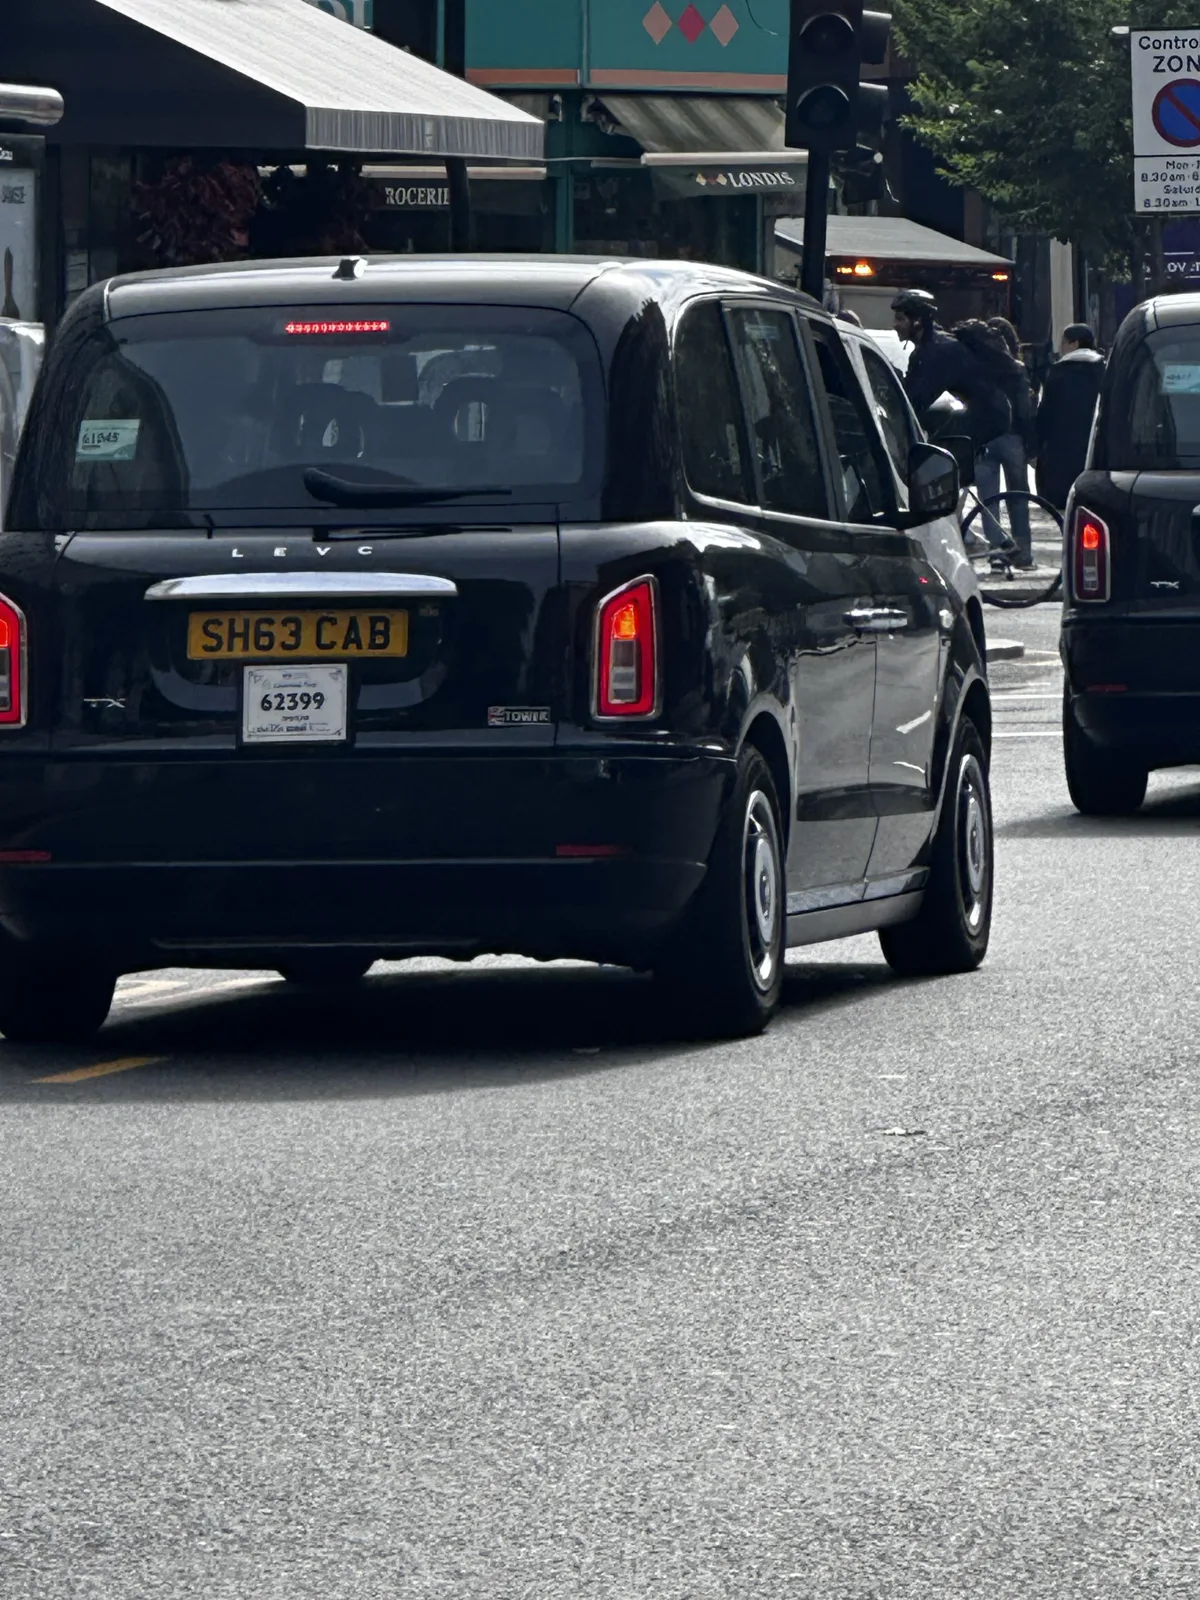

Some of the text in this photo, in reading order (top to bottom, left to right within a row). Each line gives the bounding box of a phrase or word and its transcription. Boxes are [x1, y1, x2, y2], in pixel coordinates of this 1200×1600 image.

[1138, 35, 1200, 50] Contro
[1166, 160, 1189, 170] Mon
[727, 171, 795, 188] LONDIS
[231, 546, 373, 558] LEVC
[202, 614, 391, 653] SH63 CAB
[260, 692, 325, 711] 62399
